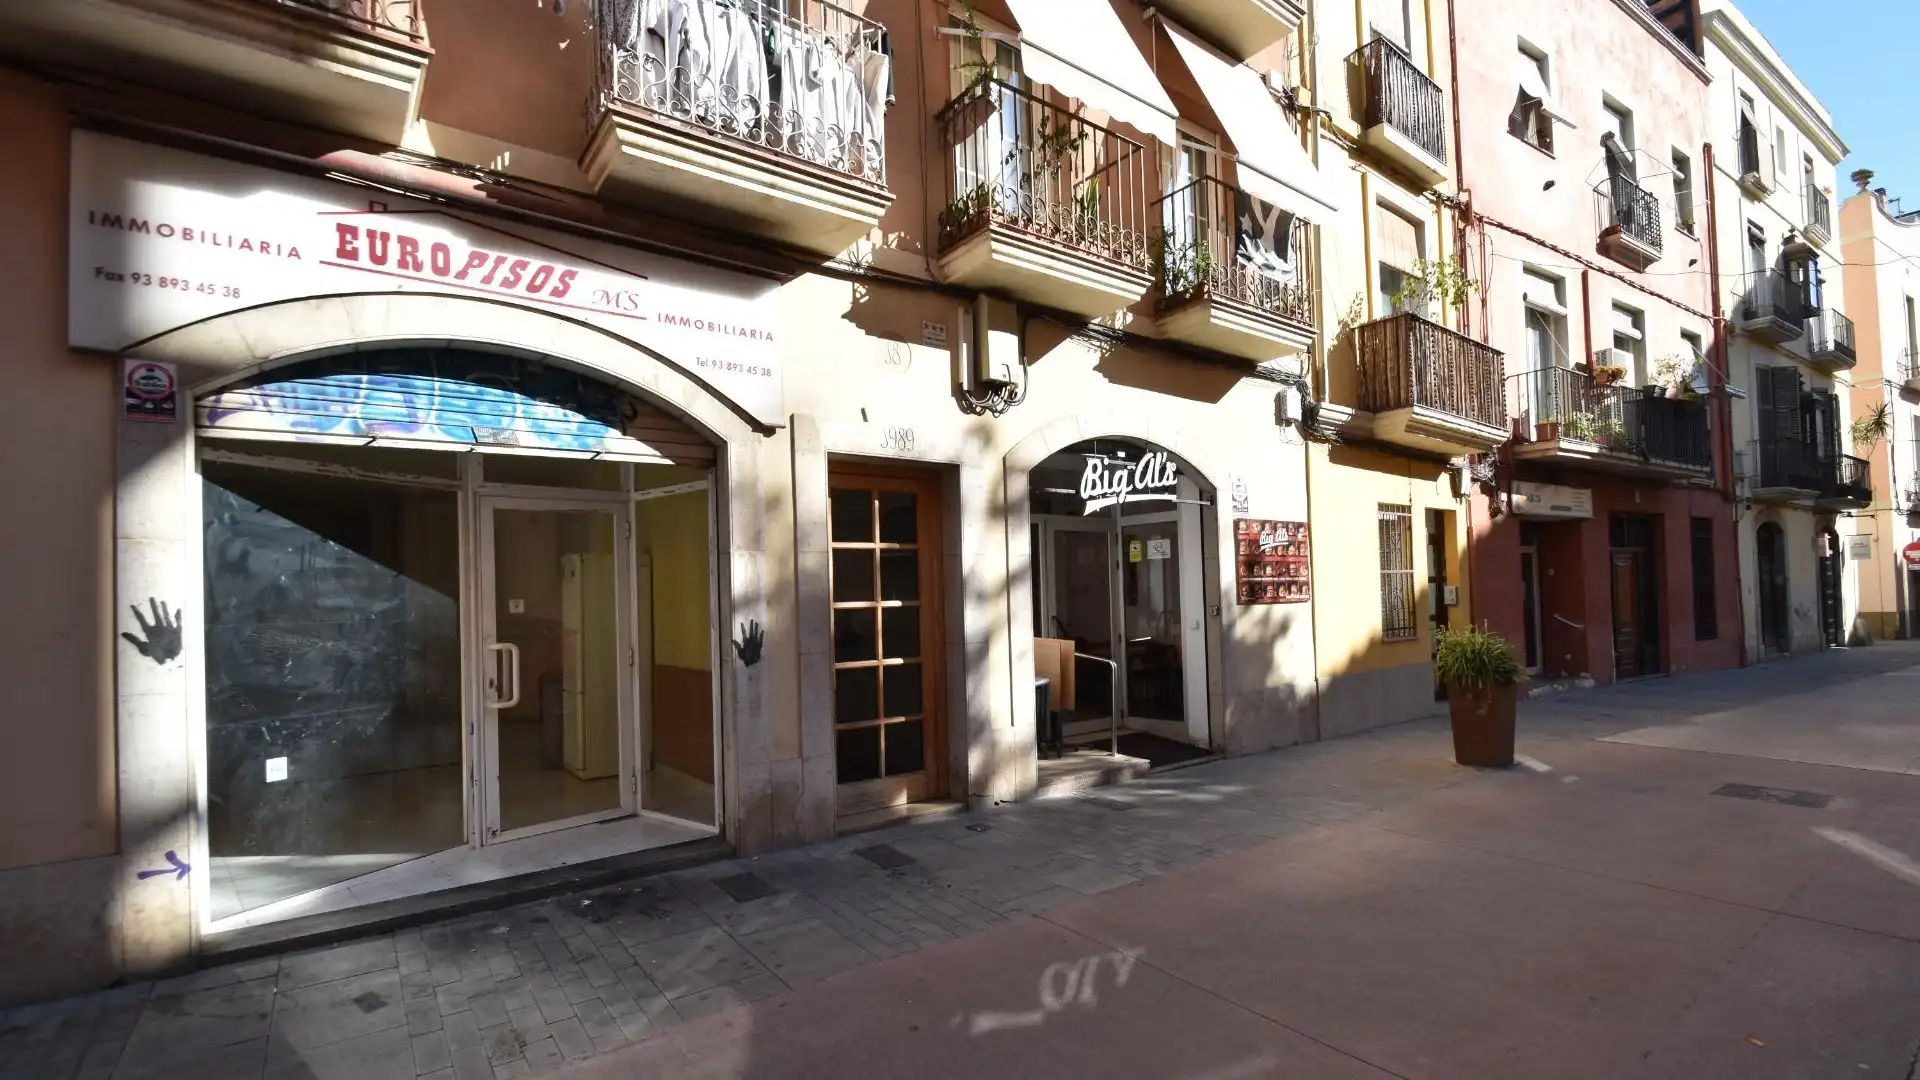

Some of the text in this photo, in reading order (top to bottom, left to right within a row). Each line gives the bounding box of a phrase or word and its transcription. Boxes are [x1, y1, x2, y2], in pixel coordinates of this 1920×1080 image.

[88, 209, 302, 260] IMMOBILIARIA
[335, 222, 580, 299] EUROPISOS
[94, 266, 241, 300] Fax 93 893 45 38
[657, 312, 774, 342] IMMOBILIARIA
[696, 356, 772, 378] Tel 93 893 45 38
[1080, 456, 1134, 504] Big
[1260, 531, 1274, 545] Big
